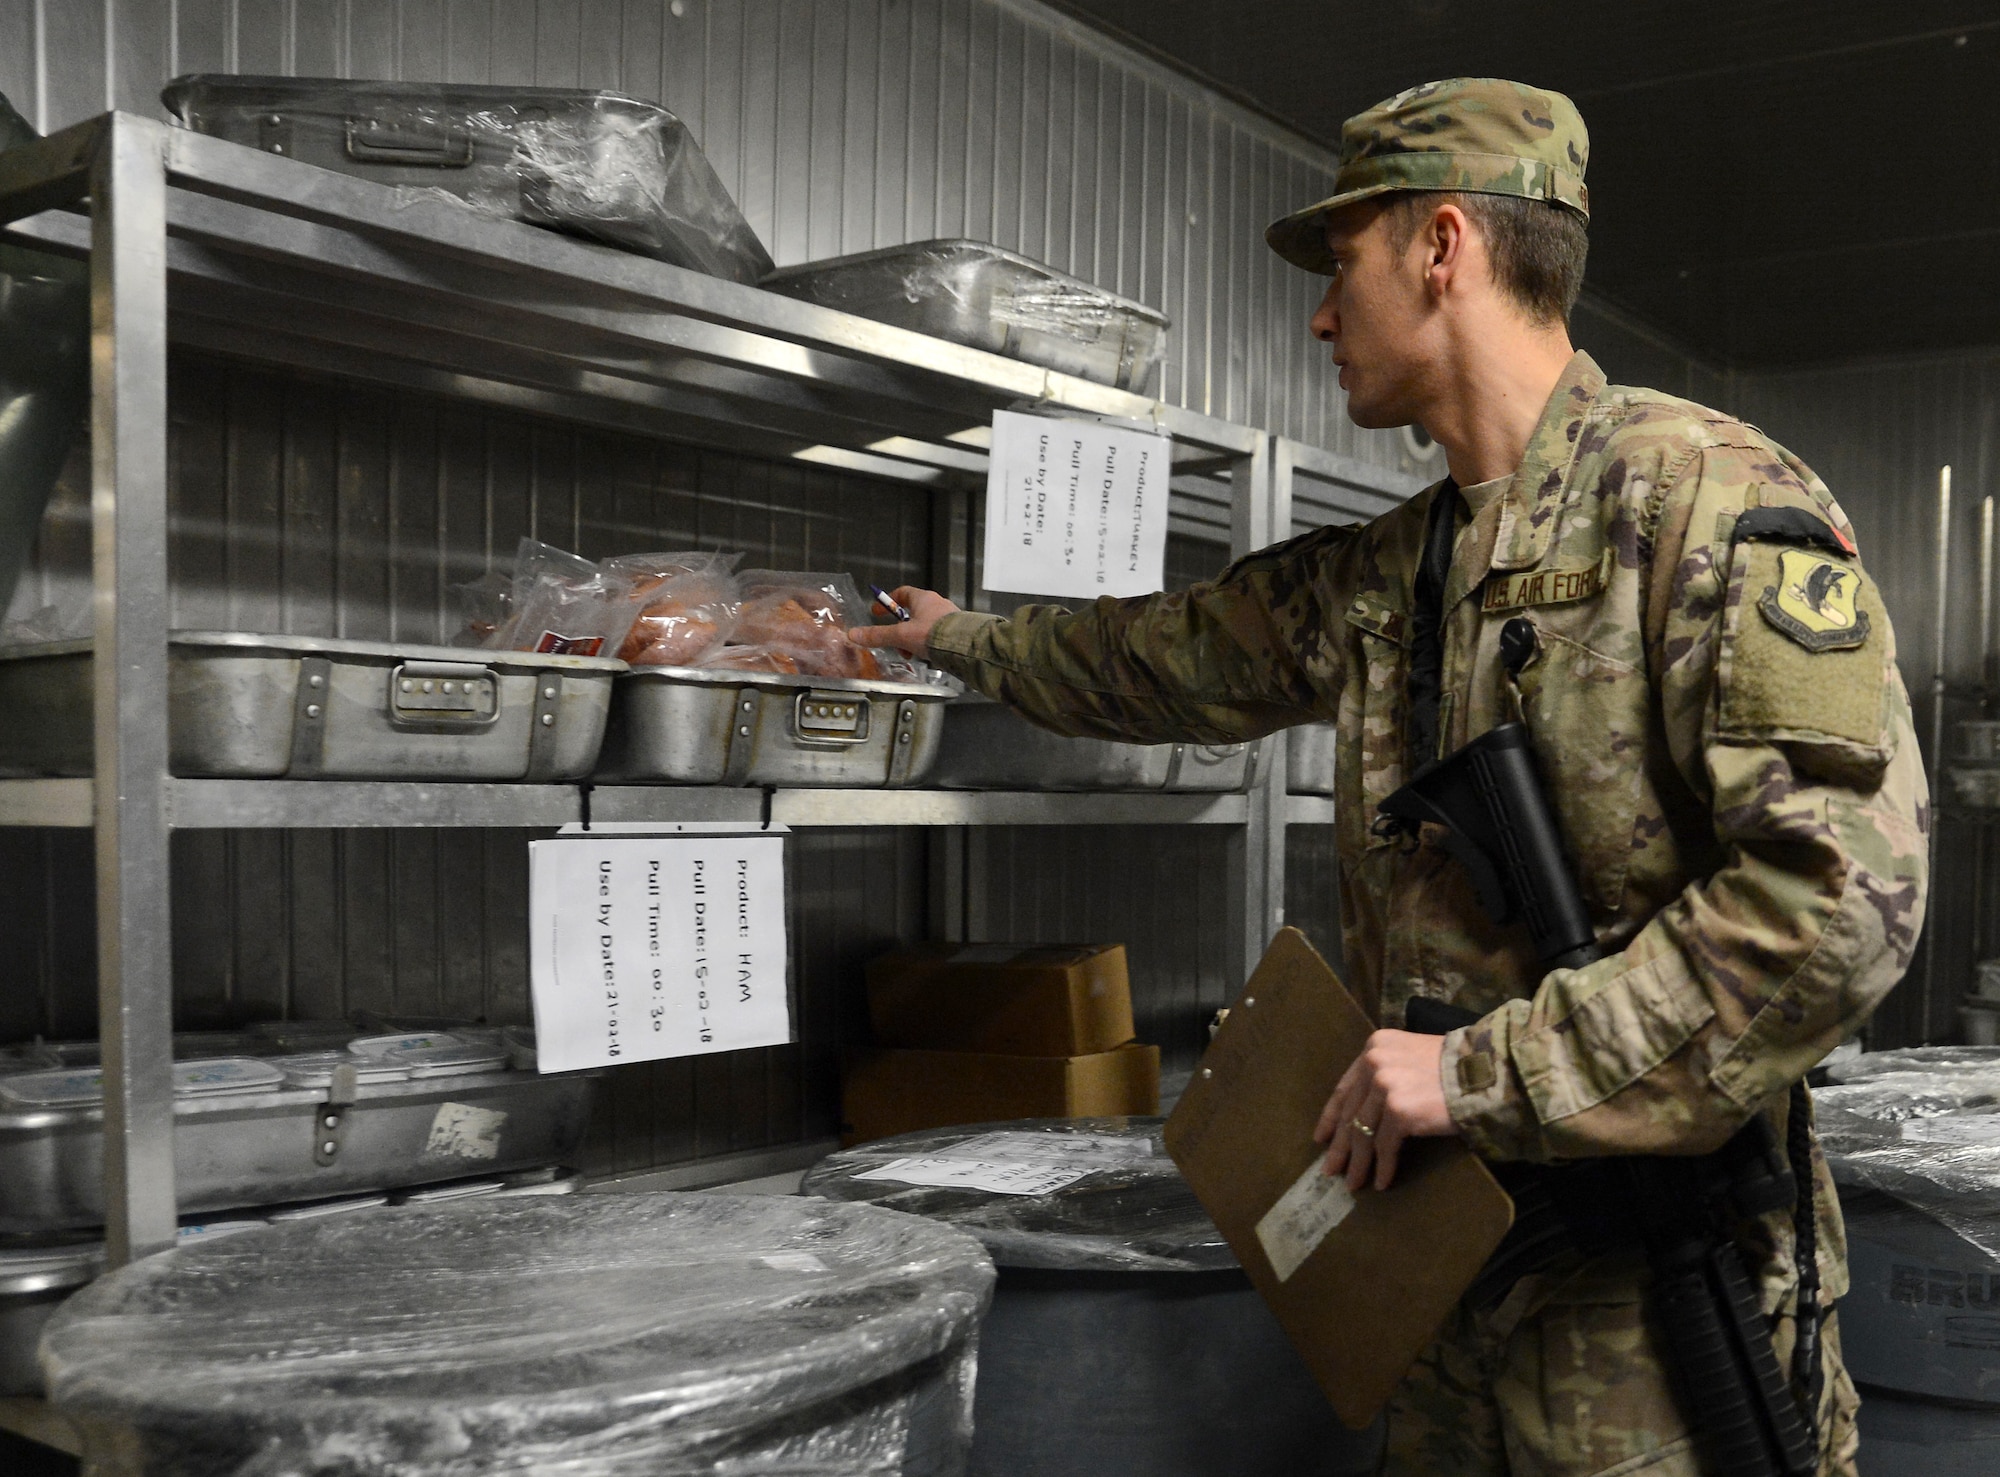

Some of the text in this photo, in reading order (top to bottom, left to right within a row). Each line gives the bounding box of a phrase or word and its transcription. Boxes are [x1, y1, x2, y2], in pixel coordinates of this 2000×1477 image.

[1071, 440, 1082, 469] Pull
[1105, 445, 1117, 474] Pull
[1036, 434, 1049, 534] Use by Date:
[1067, 474, 1079, 517] Time:
[1099, 479, 1113, 520] Date:
[1133, 451, 1149, 514] Product:
[1484, 563, 1602, 609] U.S. AIR FOR
[648, 860, 660, 895] Pull
[693, 860, 706, 895] Pull
[649, 902, 660, 957] Time:
[694, 902, 706, 952] Date:
[737, 859, 752, 1002] Product: HAM
[597, 860, 621, 1057] Use by Date: 21-02-18
